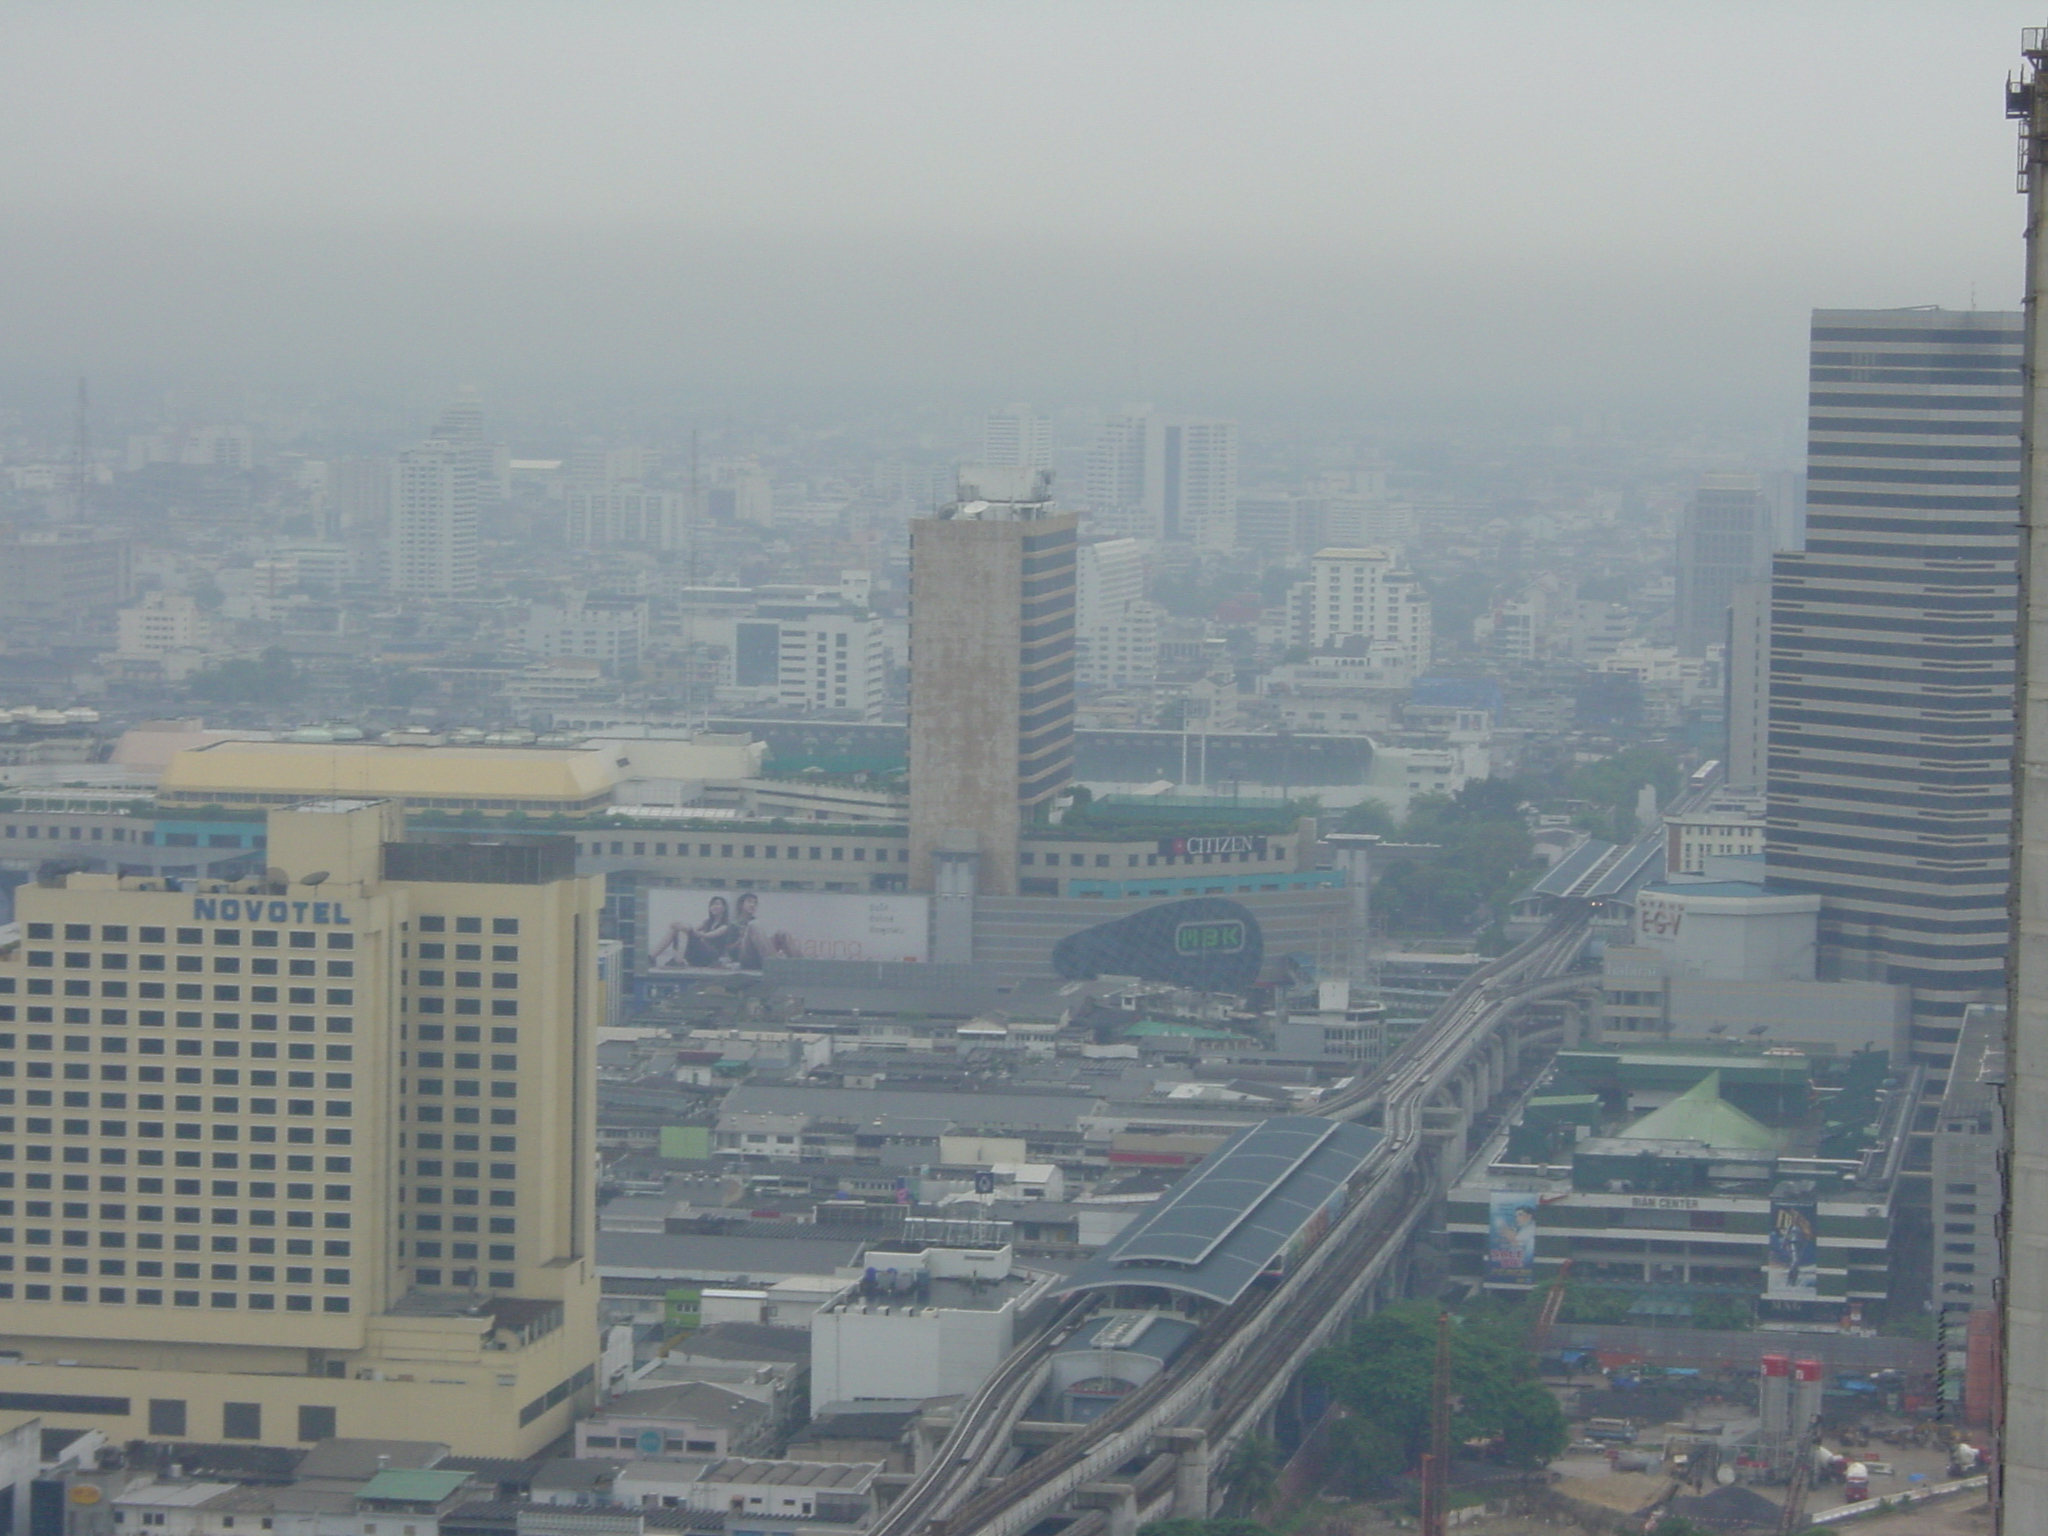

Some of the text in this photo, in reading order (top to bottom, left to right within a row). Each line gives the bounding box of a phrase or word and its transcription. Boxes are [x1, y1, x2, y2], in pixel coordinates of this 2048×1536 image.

[1187, 836, 1252, 854] CITIZEN
[194, 898, 351, 925] NOVOTEL
[1179, 927, 1239, 949] MBK
[1659, 1199, 1698, 1209] CENTER
